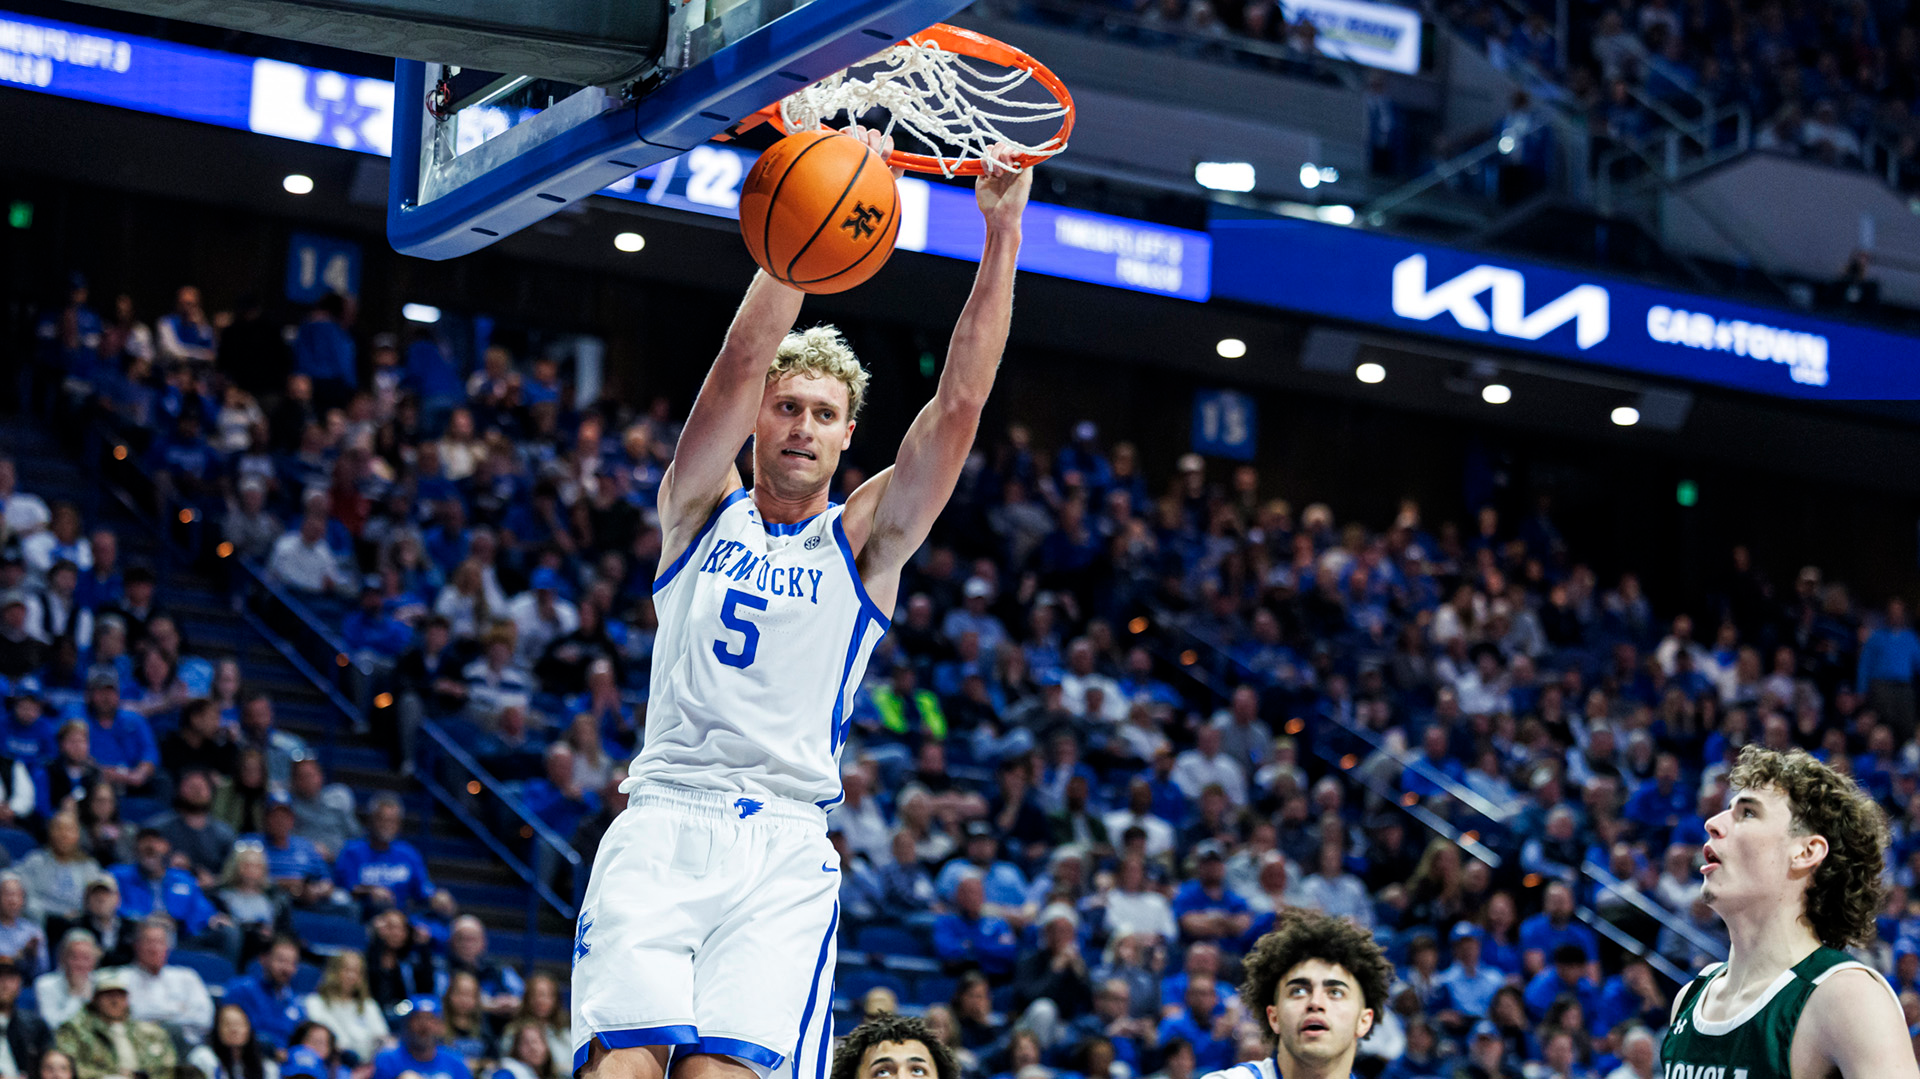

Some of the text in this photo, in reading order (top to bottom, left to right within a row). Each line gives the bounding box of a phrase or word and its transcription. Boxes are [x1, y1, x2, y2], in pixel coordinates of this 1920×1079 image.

[686, 145, 742, 209] 22
[1391, 253, 1611, 350] KIA
[700, 538, 823, 605] KENUCKY
[712, 587, 769, 670] 5
